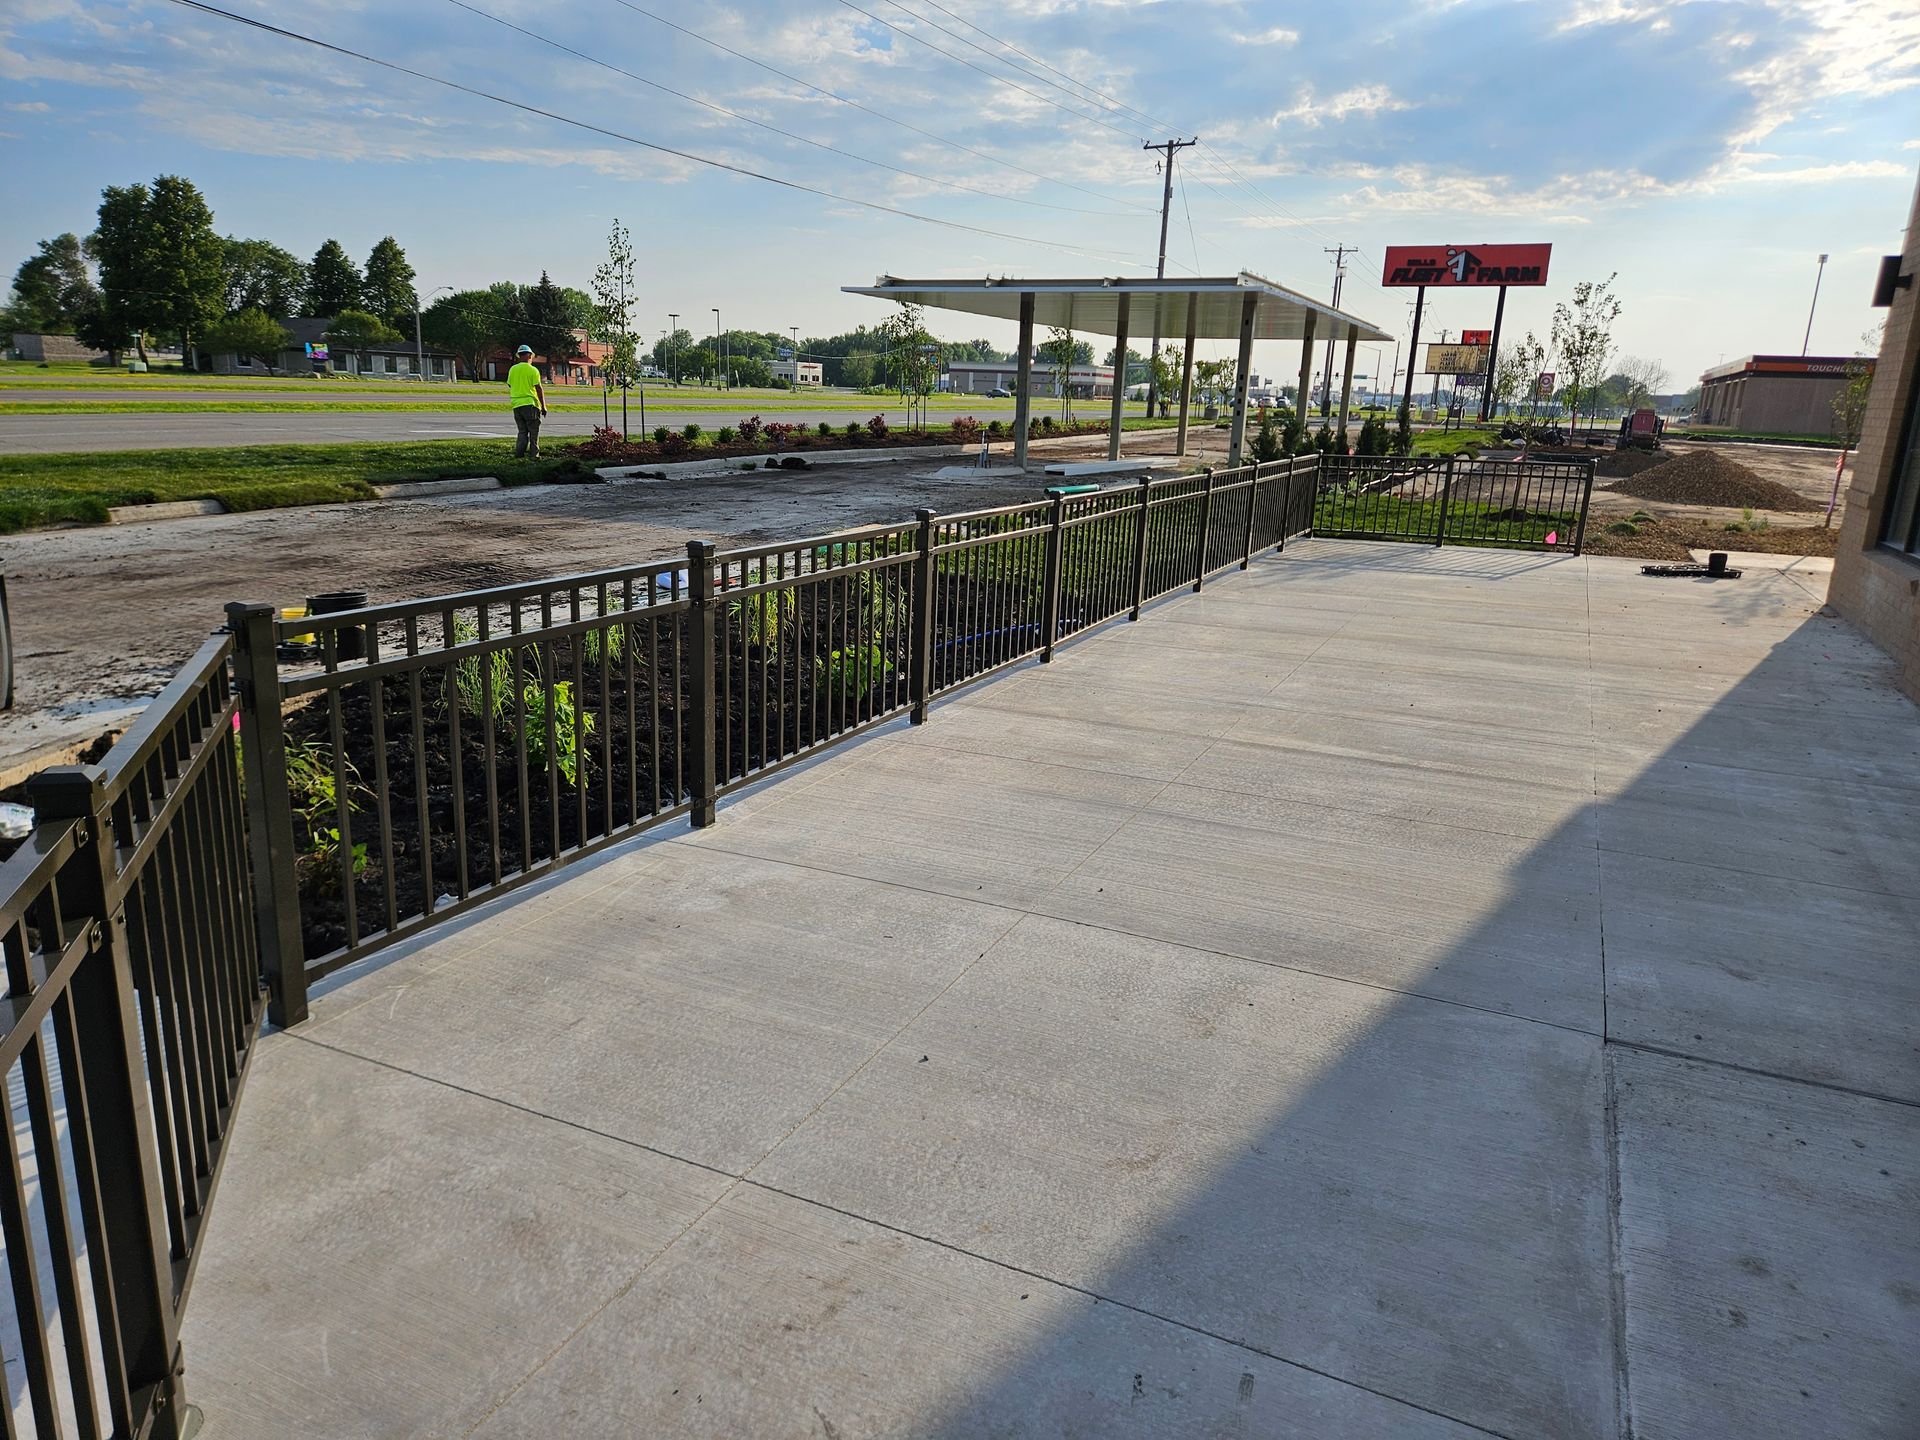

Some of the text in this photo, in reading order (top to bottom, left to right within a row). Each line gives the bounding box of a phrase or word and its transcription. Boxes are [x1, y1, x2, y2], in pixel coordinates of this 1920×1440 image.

[1390, 266, 1541, 282] FLEET FARM
[1807, 364, 1866, 373] TOUCHLSS
